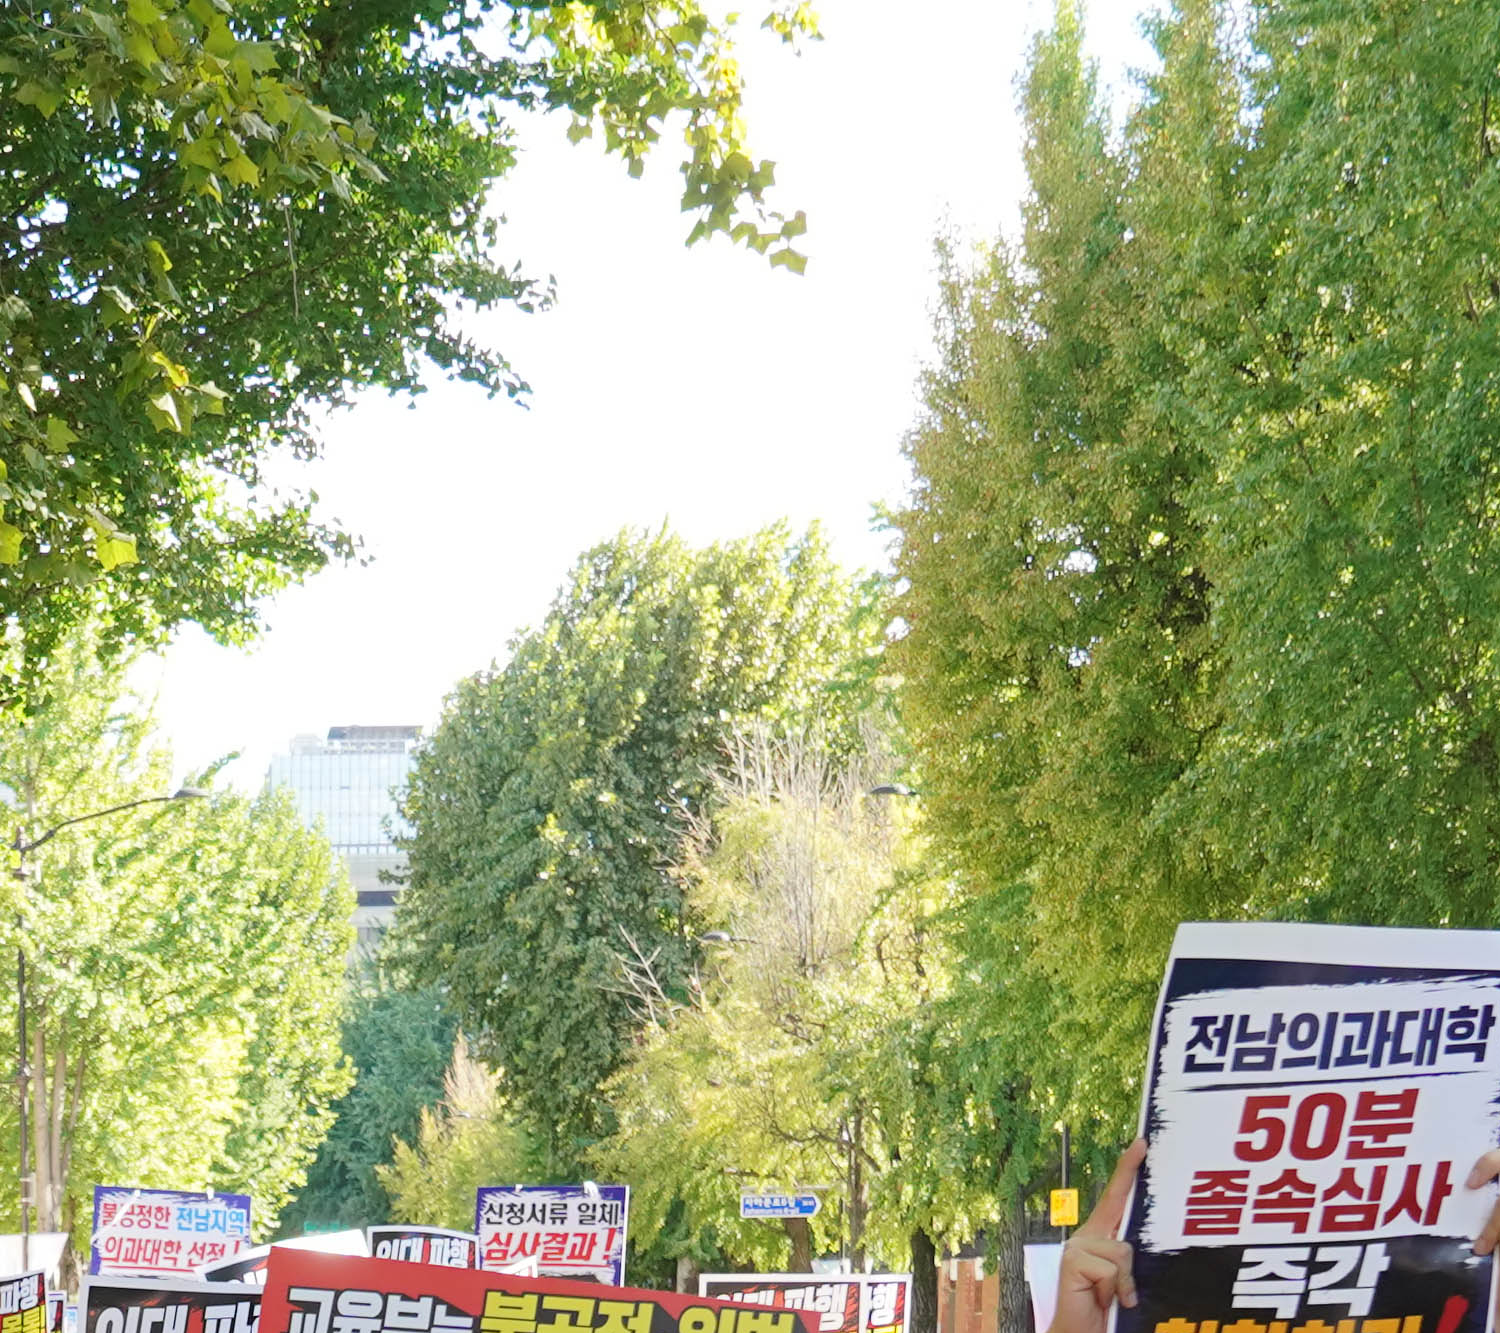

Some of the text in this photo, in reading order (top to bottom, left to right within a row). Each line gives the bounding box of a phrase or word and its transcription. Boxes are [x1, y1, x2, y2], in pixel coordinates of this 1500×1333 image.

[1183, 1005, 1496, 1075] 전남의과대학
[1234, 1088, 1420, 1162] 50분
[176, 1208, 245, 1234] 전남지역
[483, 1202, 567, 1225] 신청서류
[1183, 1161, 1454, 1239] 졸속심사
[103, 1236, 182, 1266] 의과대학
[1232, 1242, 1391, 1319] 즉각
